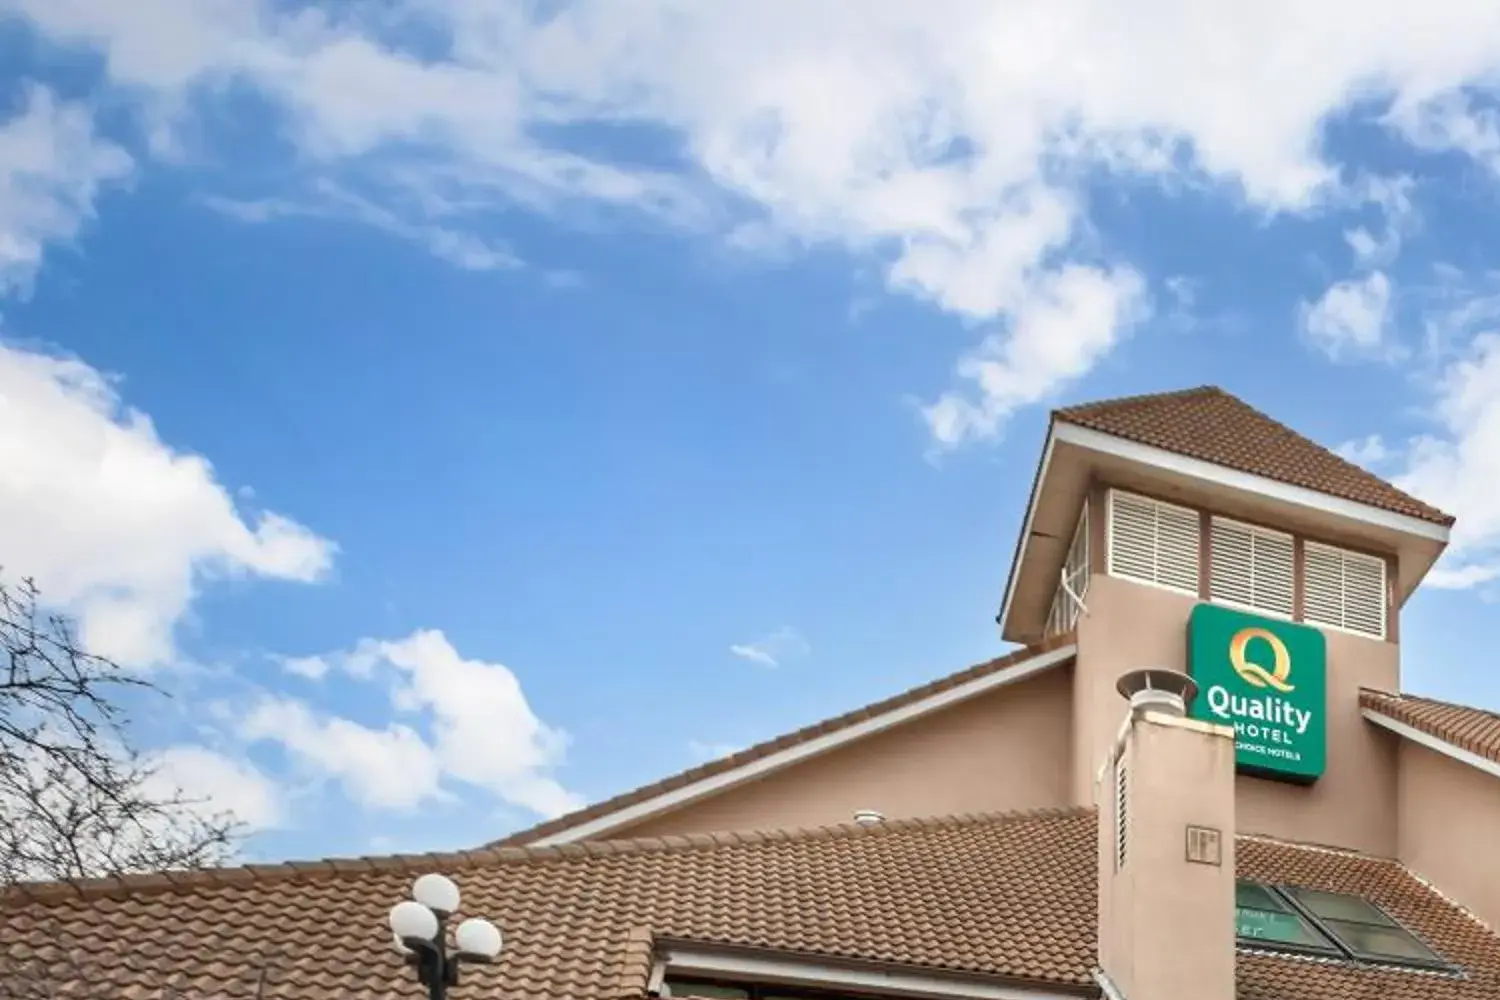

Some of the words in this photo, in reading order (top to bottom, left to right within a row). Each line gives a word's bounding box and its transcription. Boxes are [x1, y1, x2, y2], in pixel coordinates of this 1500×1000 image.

[1229, 627, 1295, 692] Q
[1207, 685, 1312, 734] Quality
[1234, 721, 1292, 744] HOTEL
[1267, 747, 1301, 761] HOTELS
